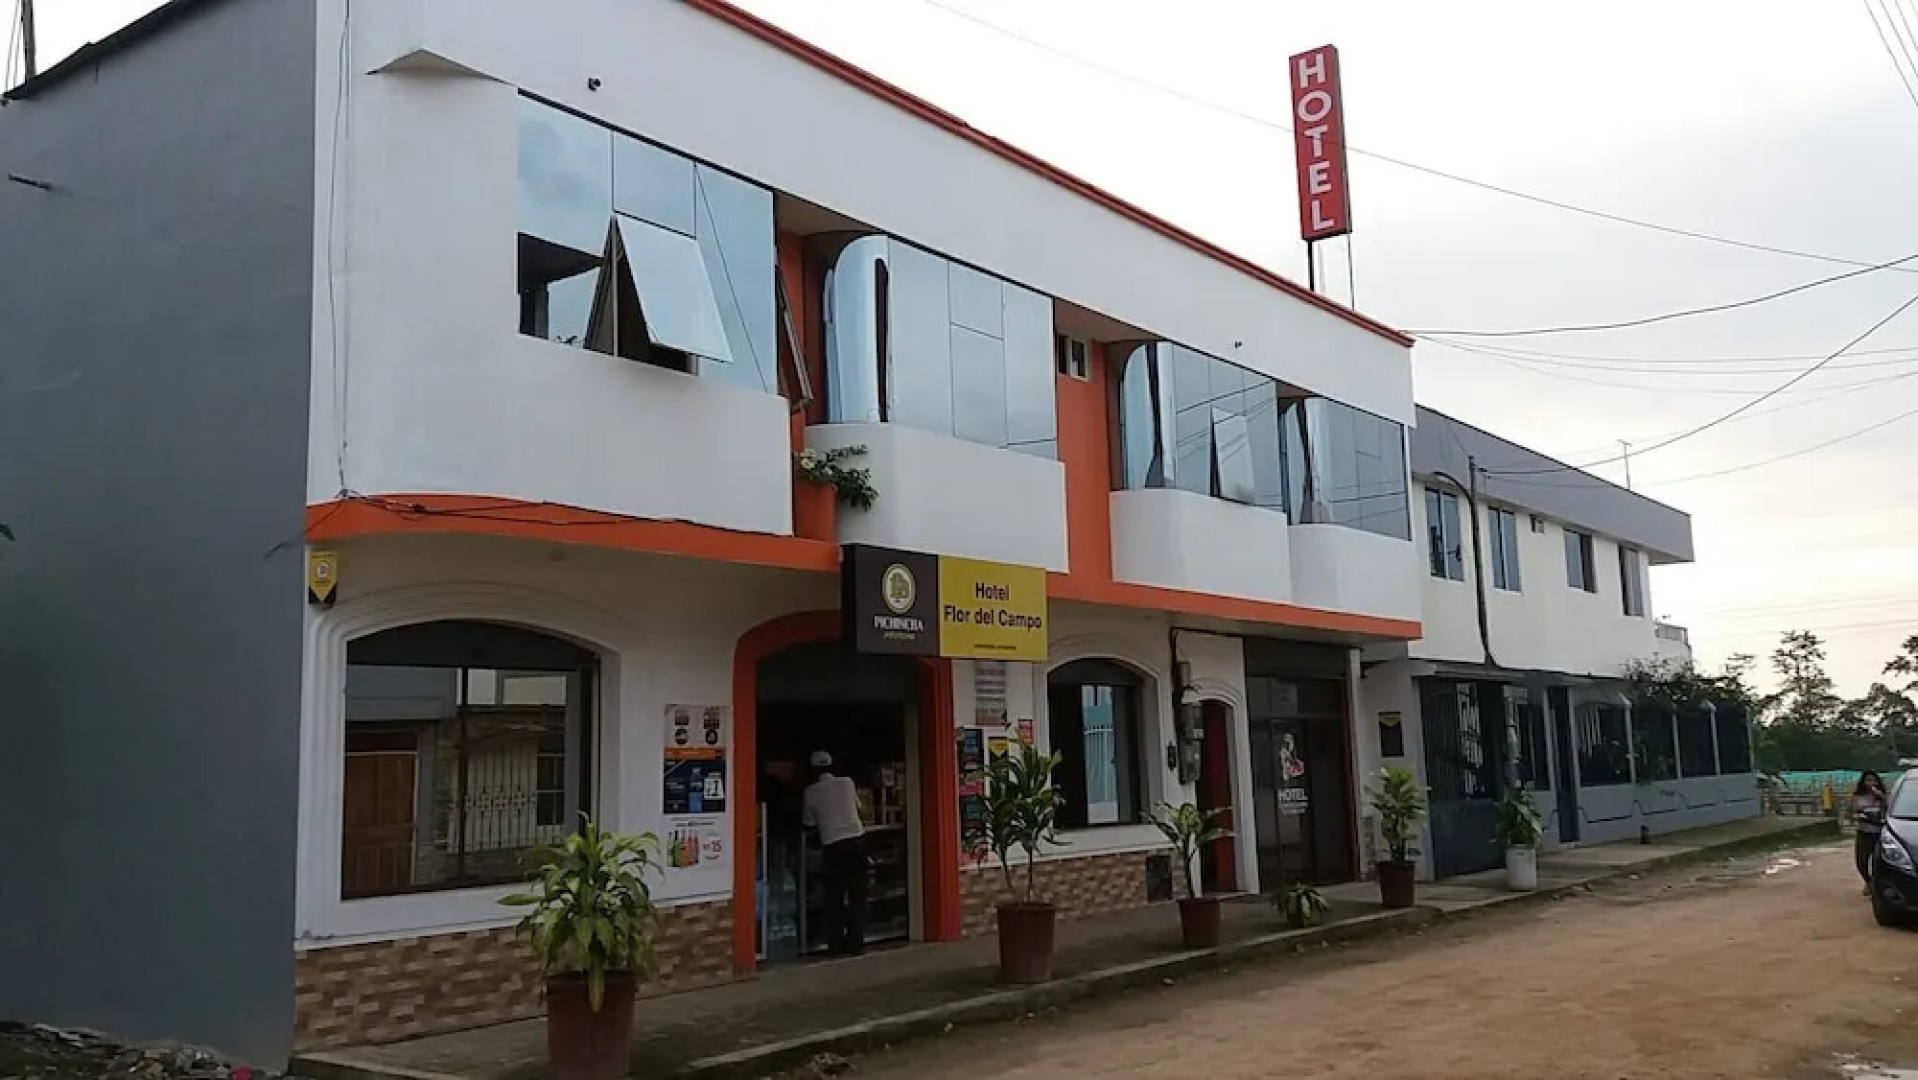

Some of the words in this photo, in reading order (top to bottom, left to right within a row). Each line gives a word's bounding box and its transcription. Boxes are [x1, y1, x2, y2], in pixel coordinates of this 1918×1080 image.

[1298, 54, 1334, 231] HOTEL
[975, 582, 1010, 601] Hotel
[944, 605, 971, 623] Flor
[974, 607, 994, 626] del
[999, 609, 1042, 632] Campo
[1278, 788, 1309, 801] HOTEL
